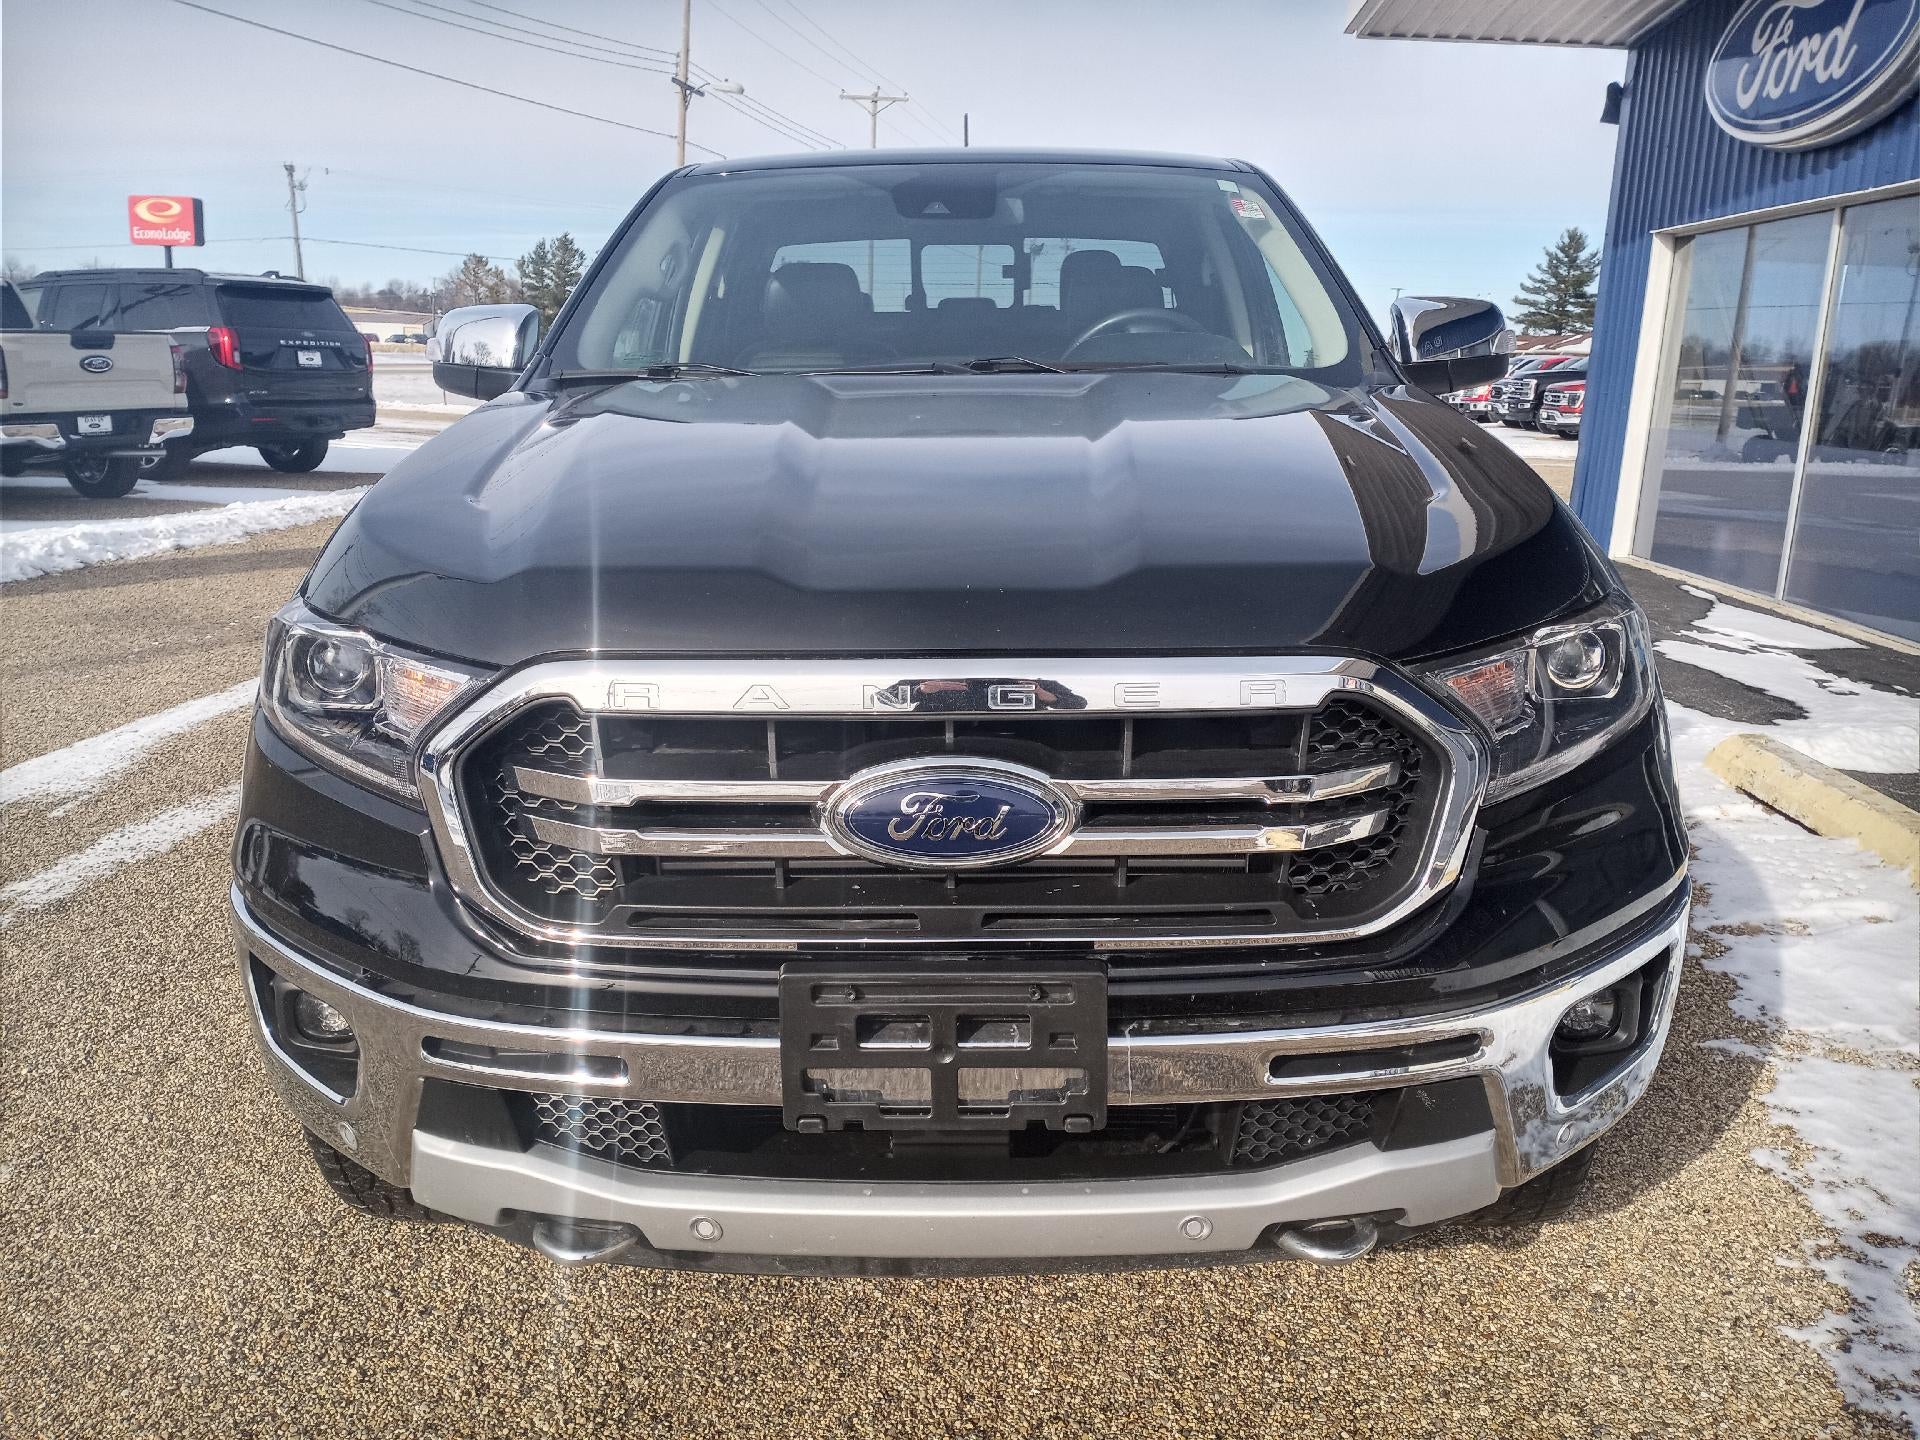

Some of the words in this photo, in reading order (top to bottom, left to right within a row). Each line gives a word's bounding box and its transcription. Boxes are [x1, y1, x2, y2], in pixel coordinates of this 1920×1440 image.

[1736, 0, 1865, 110] Ford
[612, 678, 1287, 710] RANGER
[887, 791, 1012, 841] Ford
